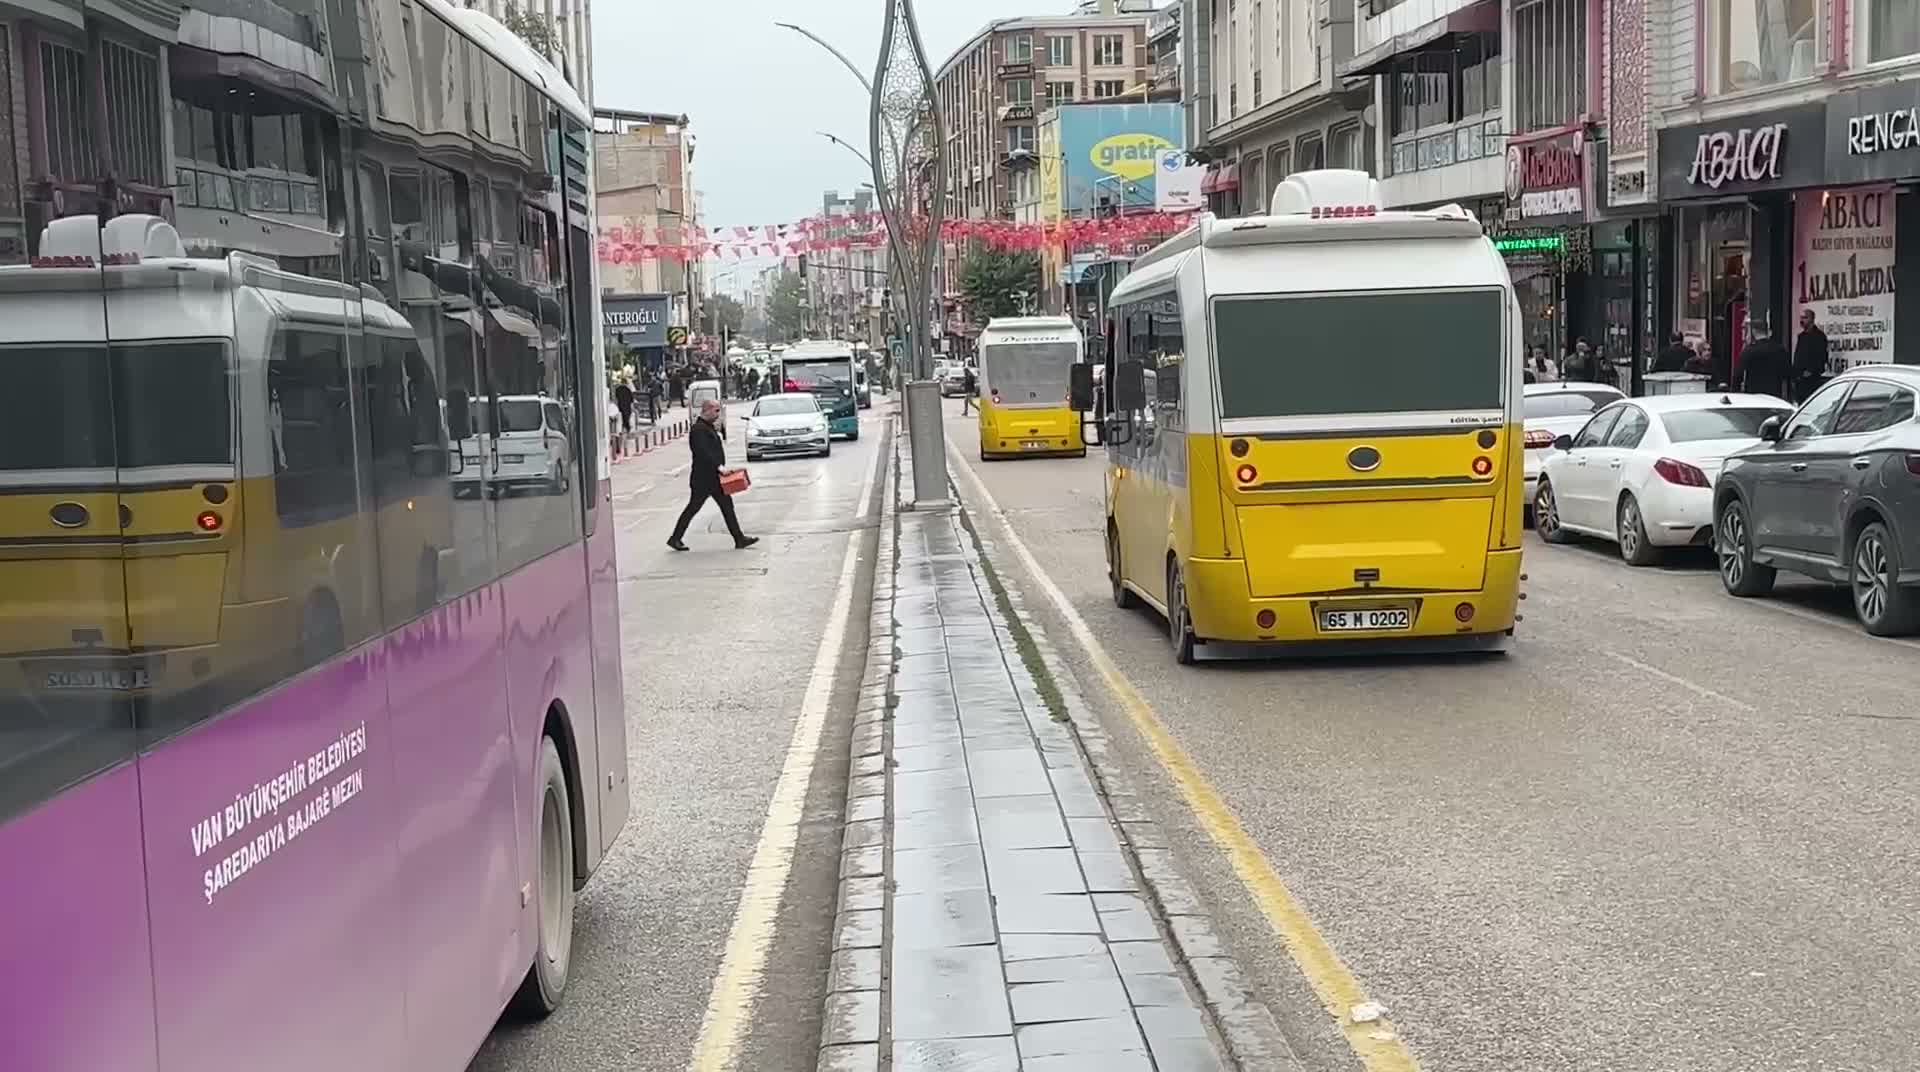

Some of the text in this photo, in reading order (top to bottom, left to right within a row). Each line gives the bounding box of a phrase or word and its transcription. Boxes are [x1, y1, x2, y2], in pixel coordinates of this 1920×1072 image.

[1687, 124, 1787, 188] ABACI
[1820, 192, 1884, 231] ABACI
[1328, 611, 1407, 627] 65 M 0202
[191, 720, 366, 857] VAN BÜYÜKŞEHİR BELEDİYESİ
[204, 768, 363, 905] ŞAREDARIYA BAJARÊ MEZIN
